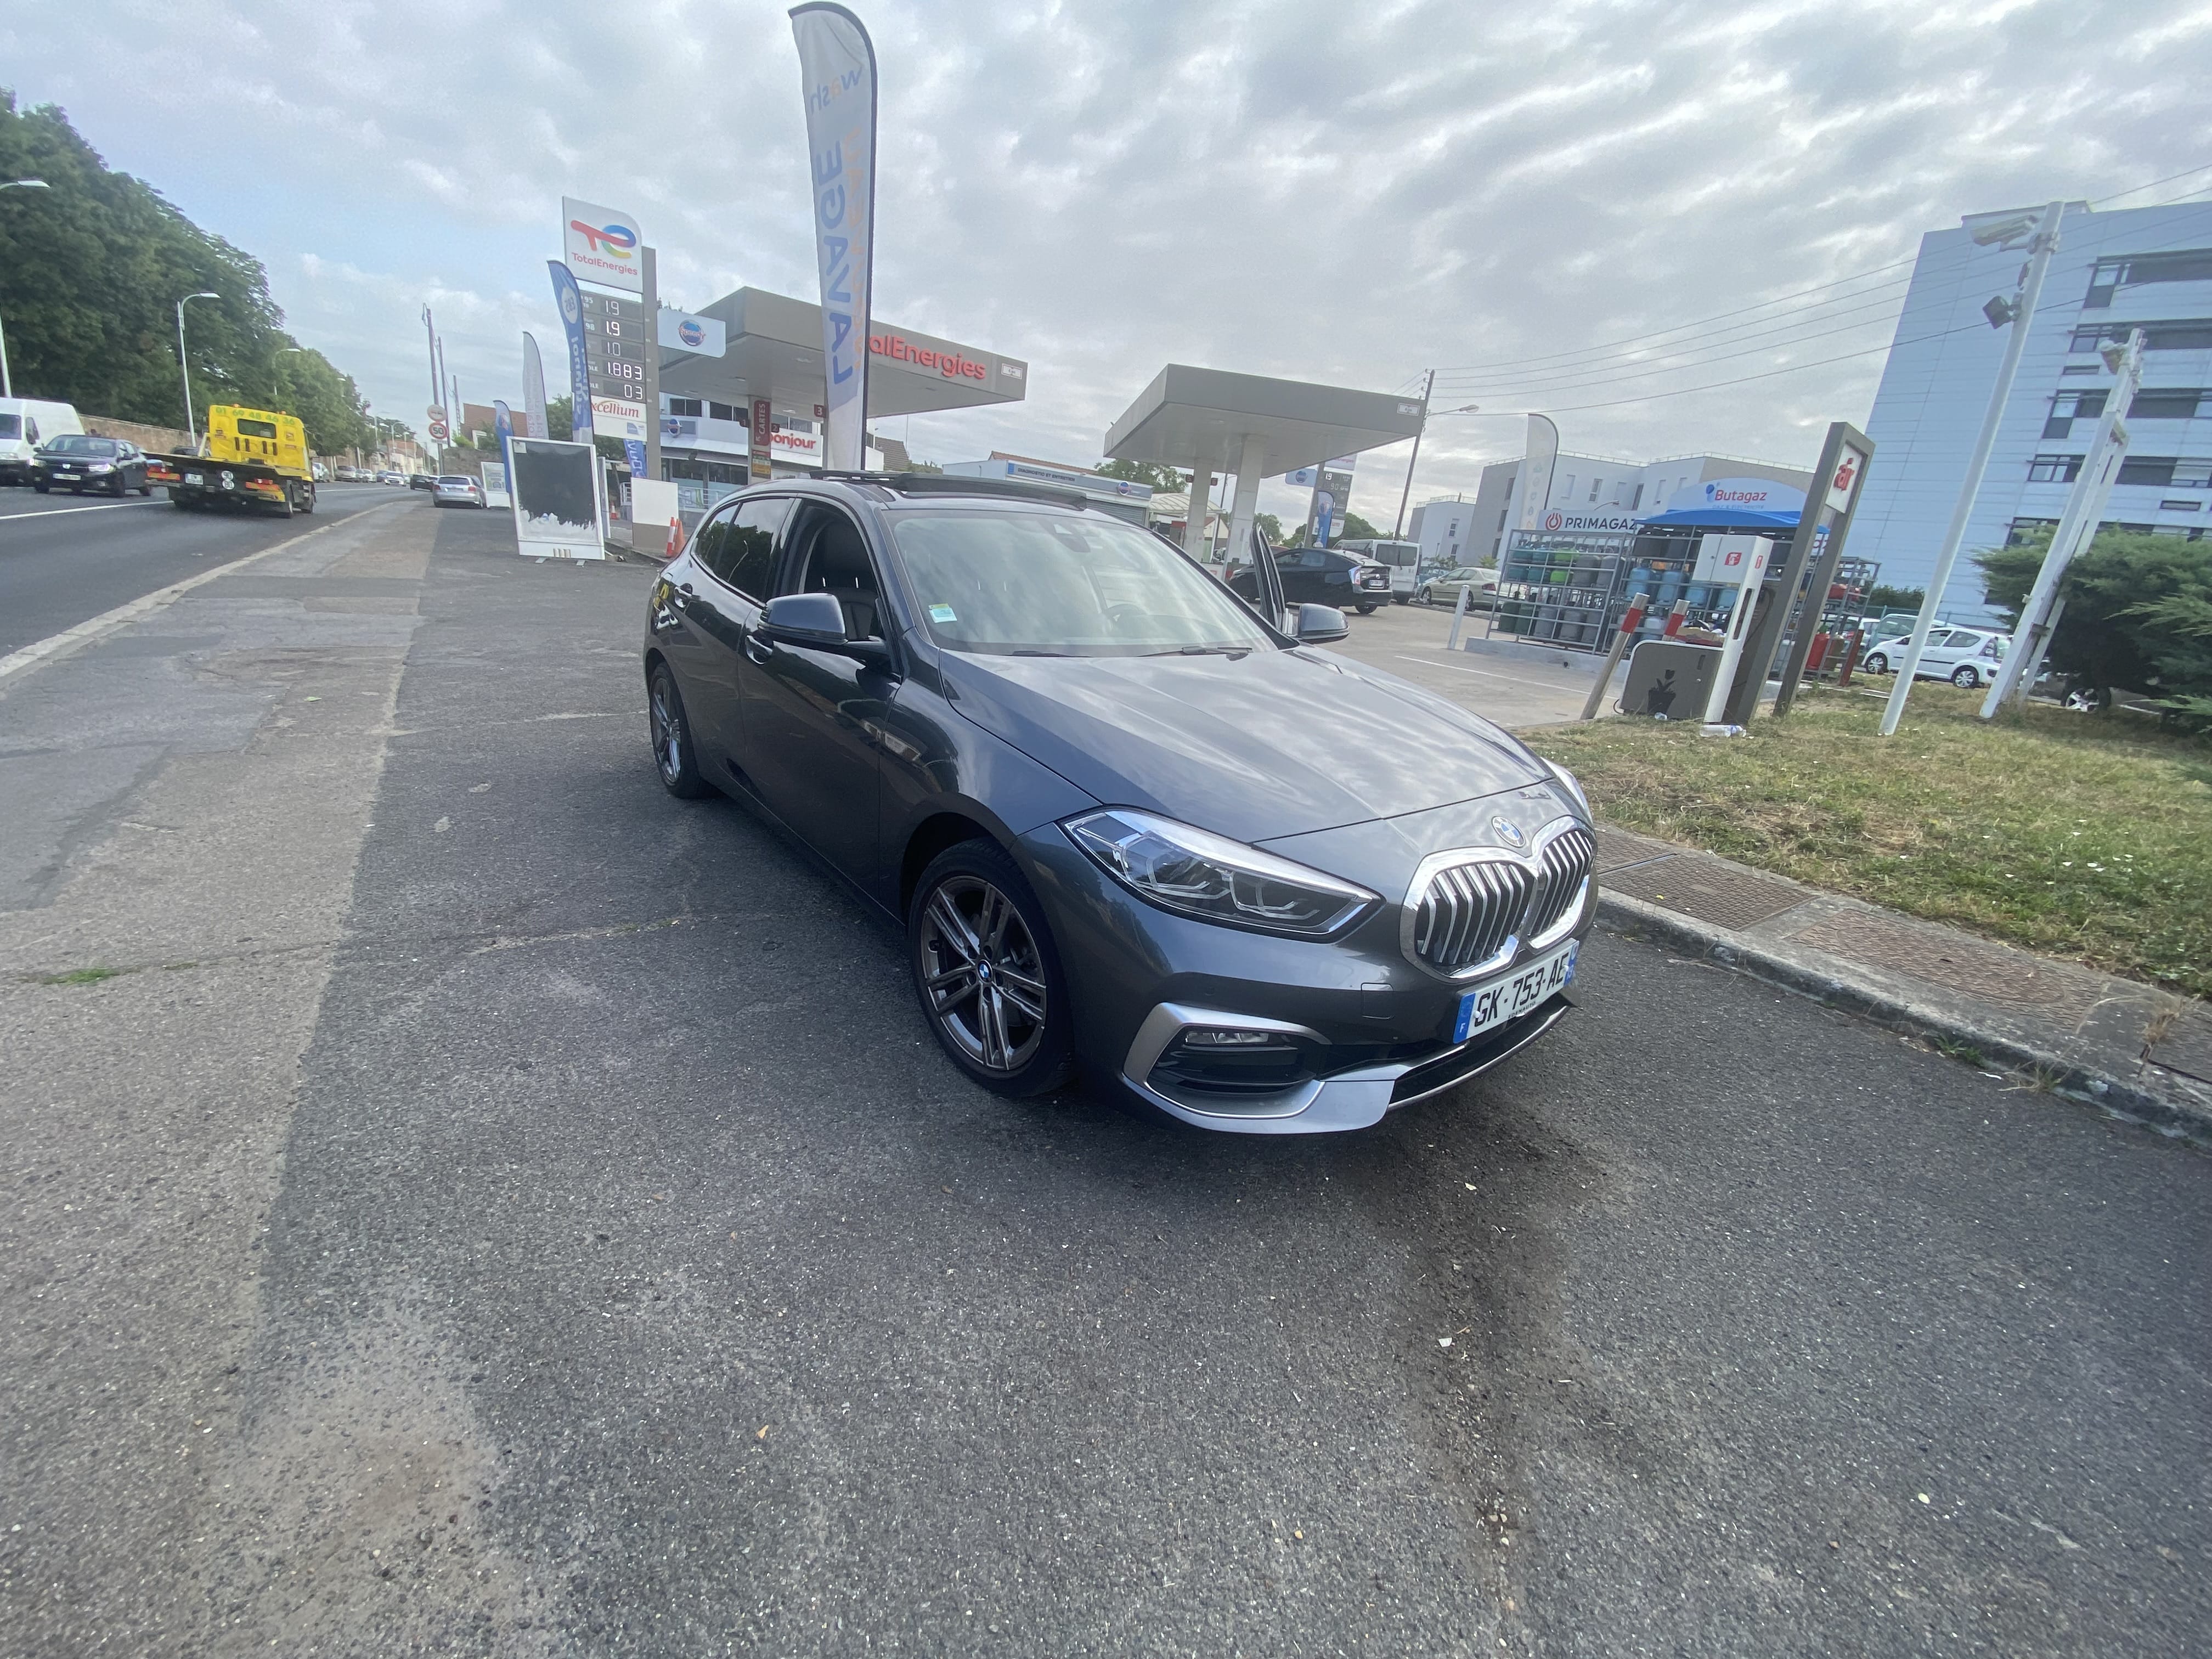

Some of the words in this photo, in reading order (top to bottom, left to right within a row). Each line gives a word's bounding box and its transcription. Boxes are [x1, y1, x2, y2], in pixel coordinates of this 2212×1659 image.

[572, 252, 637, 275] TotalEnergies
[870, 335, 986, 380] alEnergies
[608, 362, 642, 380] 1.883
[591, 402, 640, 418] xcellium
[817, 407, 823, 415] 3
[1833, 458, 1855, 491] air
[1714, 489, 1767, 503] Butagaz
[1565, 517, 1637, 530] PRIMAGAZ
[1459, 1023, 1466, 1034] F
